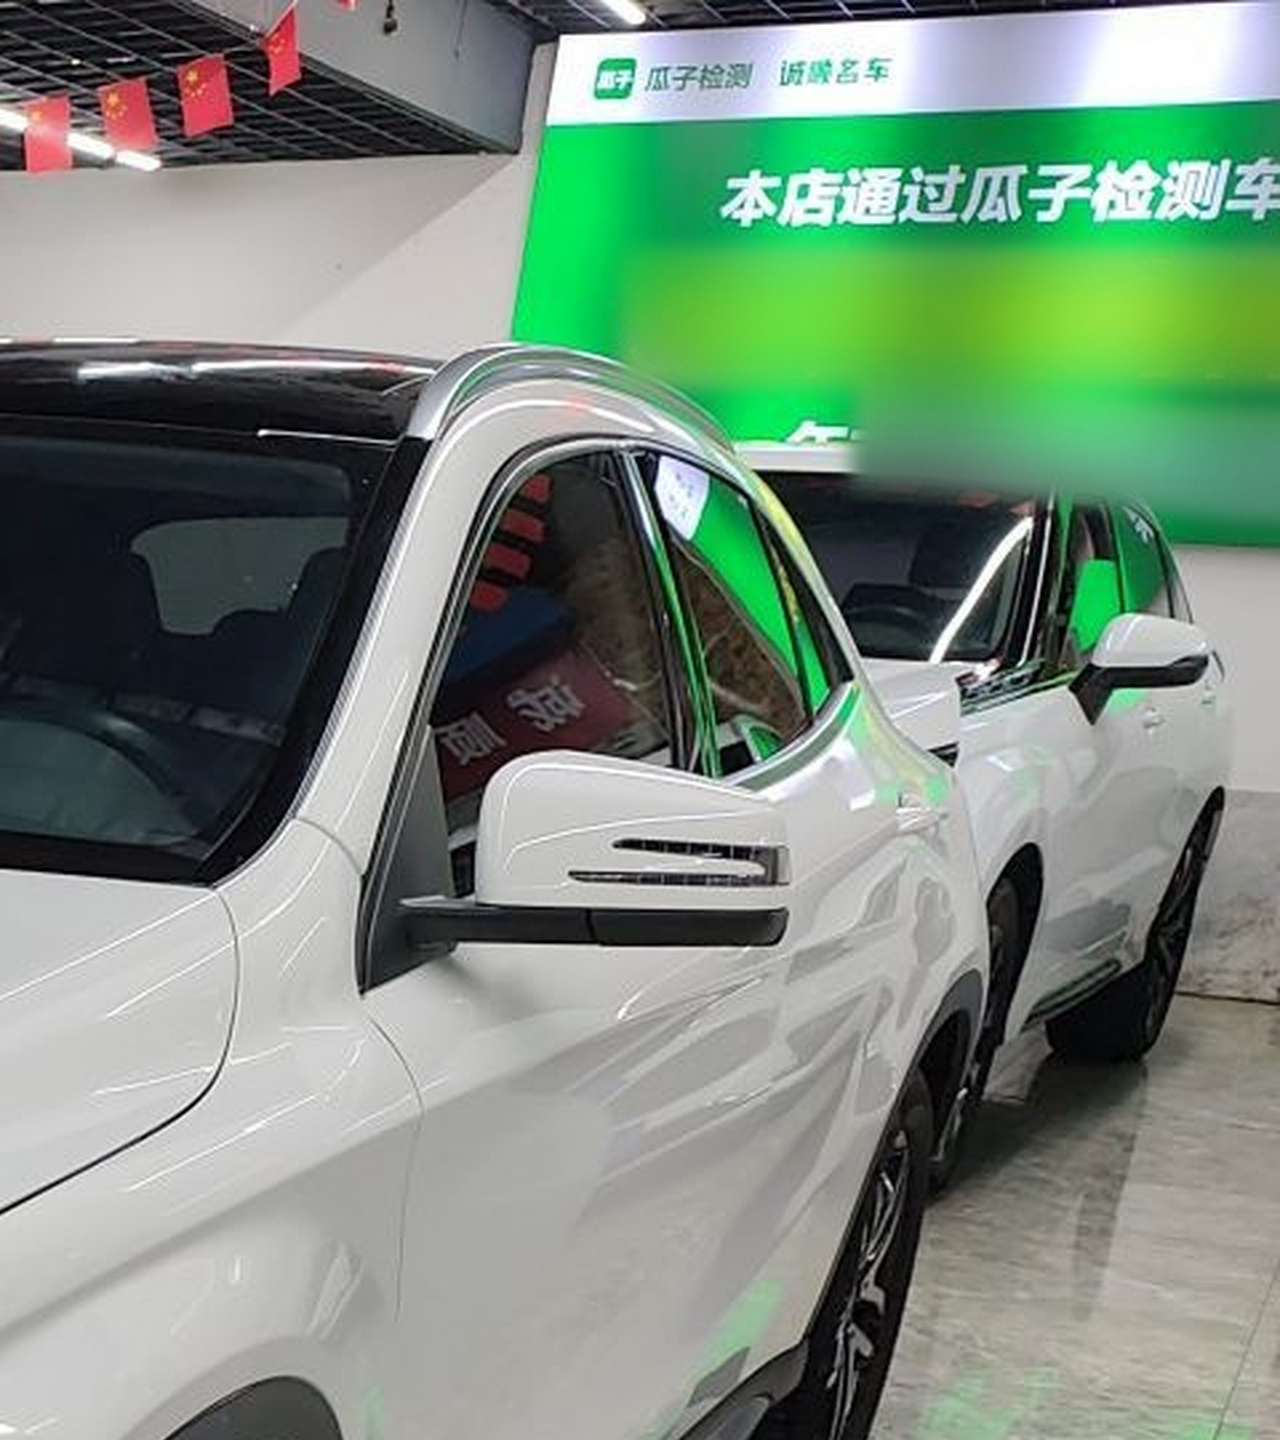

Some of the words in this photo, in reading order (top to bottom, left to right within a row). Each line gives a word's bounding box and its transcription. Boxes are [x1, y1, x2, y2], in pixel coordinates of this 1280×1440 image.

[645, 63, 753, 91] 瓜子检测
[721, 159, 1280, 228] 本店通过瓜子检测车
